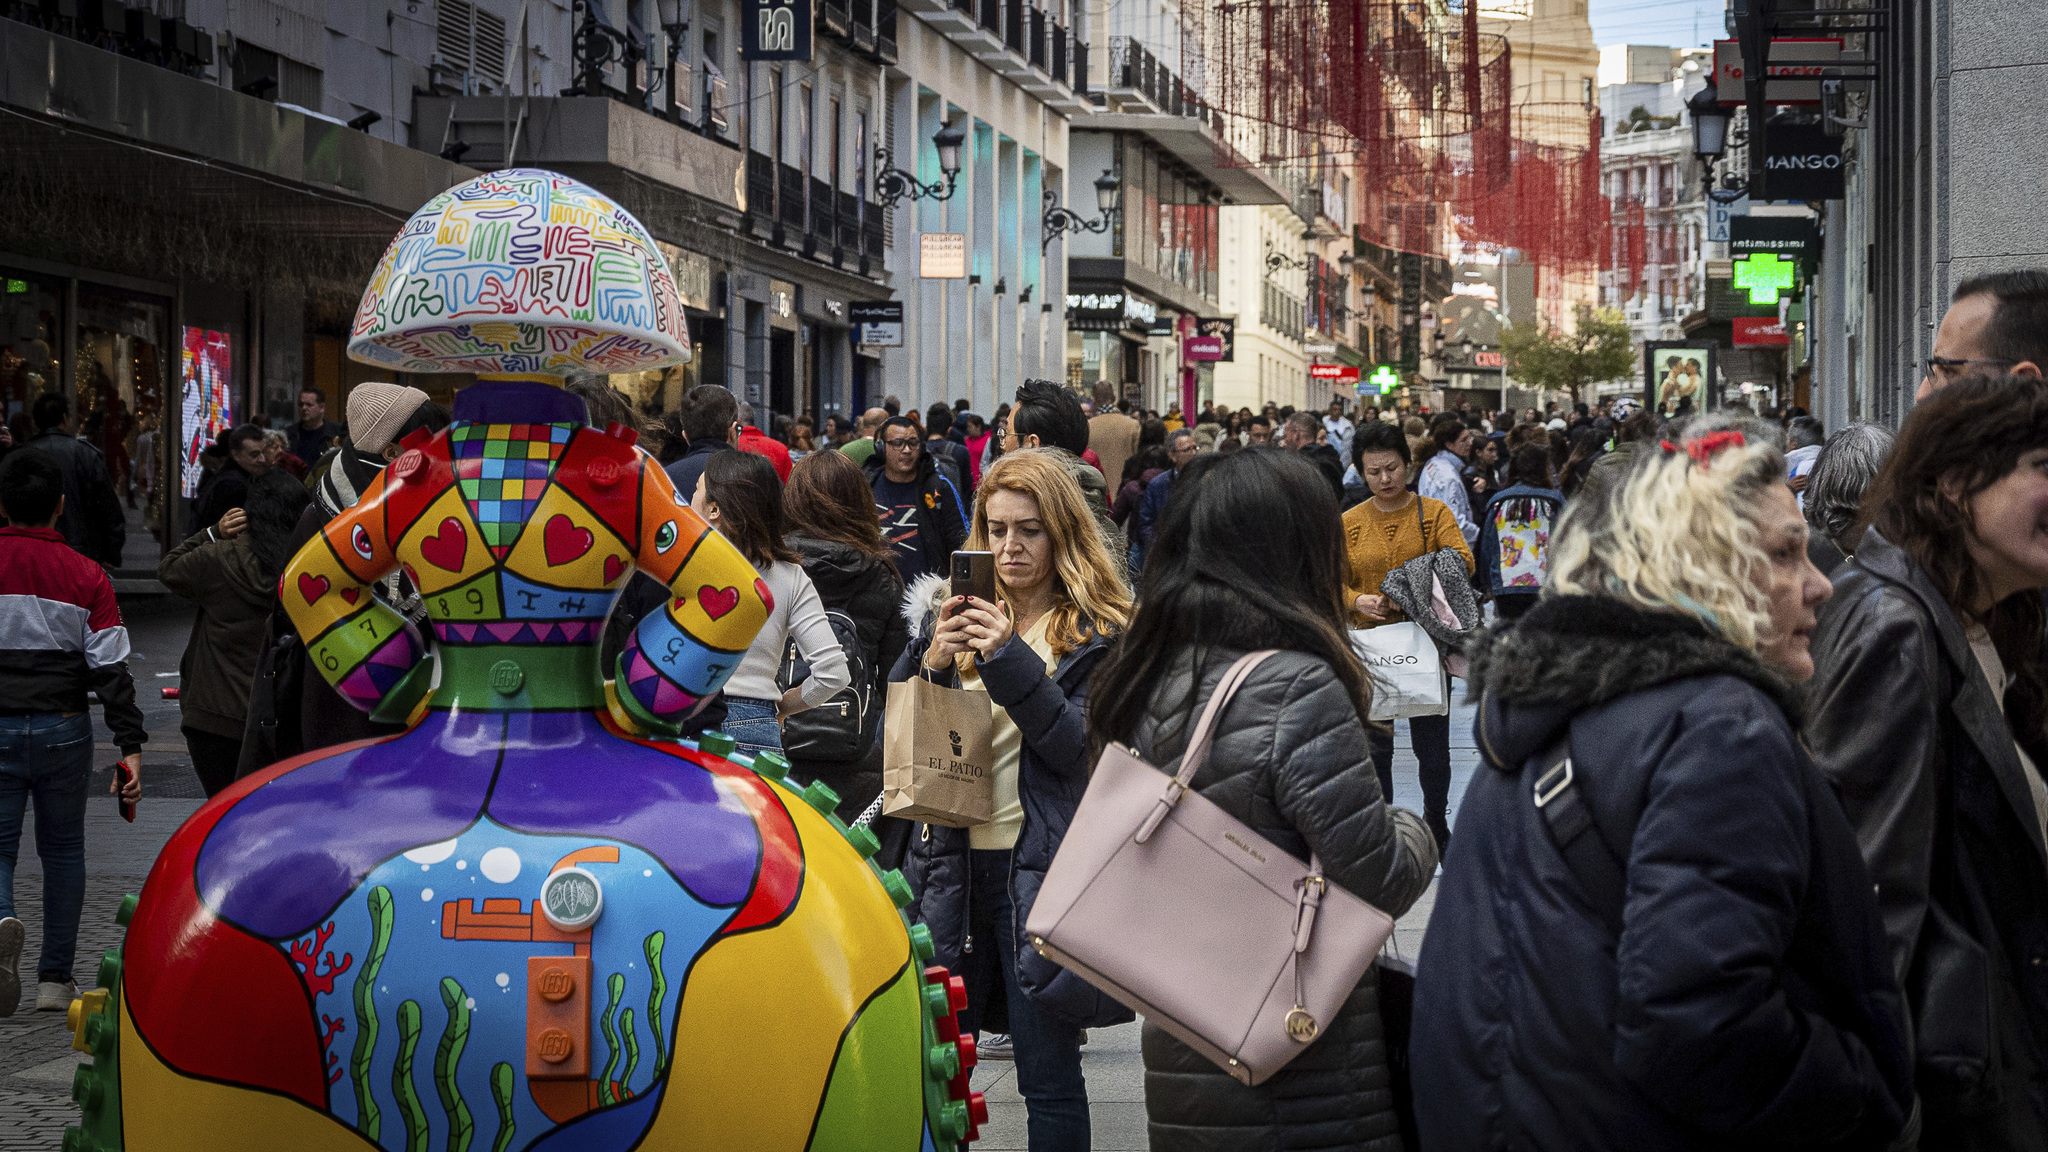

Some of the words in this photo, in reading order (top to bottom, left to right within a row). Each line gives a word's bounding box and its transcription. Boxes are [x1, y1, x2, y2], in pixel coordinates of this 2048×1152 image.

[1732, 239, 1805, 249] intimissimi
[396, 451, 420, 475] LEGO
[438, 597, 450, 617] 8
[465, 588, 484, 615] 9
[558, 596, 586, 614] H
[320, 647, 338, 671] 6
[359, 618, 378, 640] 7
[1368, 654, 1418, 667] ANGO
[492, 667, 523, 689] LEGO
[928, 757, 945, 770] EL
[949, 760, 982, 778] PATIO
[541, 972, 570, 994] LEGO
[1290, 1018, 1316, 1037] MK
[538, 1034, 569, 1056] LEGO
